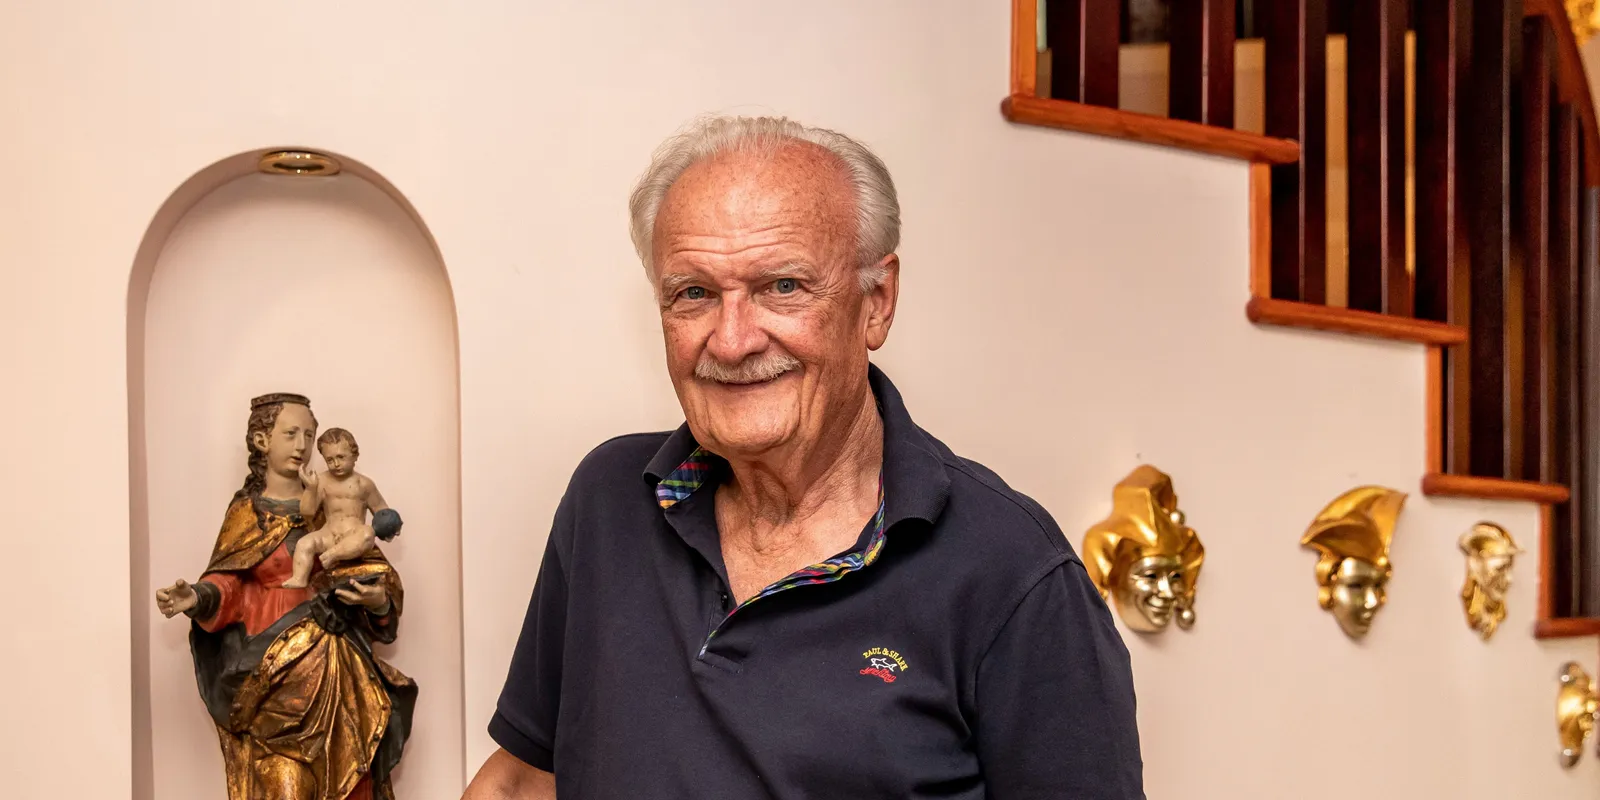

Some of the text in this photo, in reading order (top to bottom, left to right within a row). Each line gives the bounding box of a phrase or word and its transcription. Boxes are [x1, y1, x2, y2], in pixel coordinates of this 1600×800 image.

[863, 647, 908, 671] PAUL & SHARK
